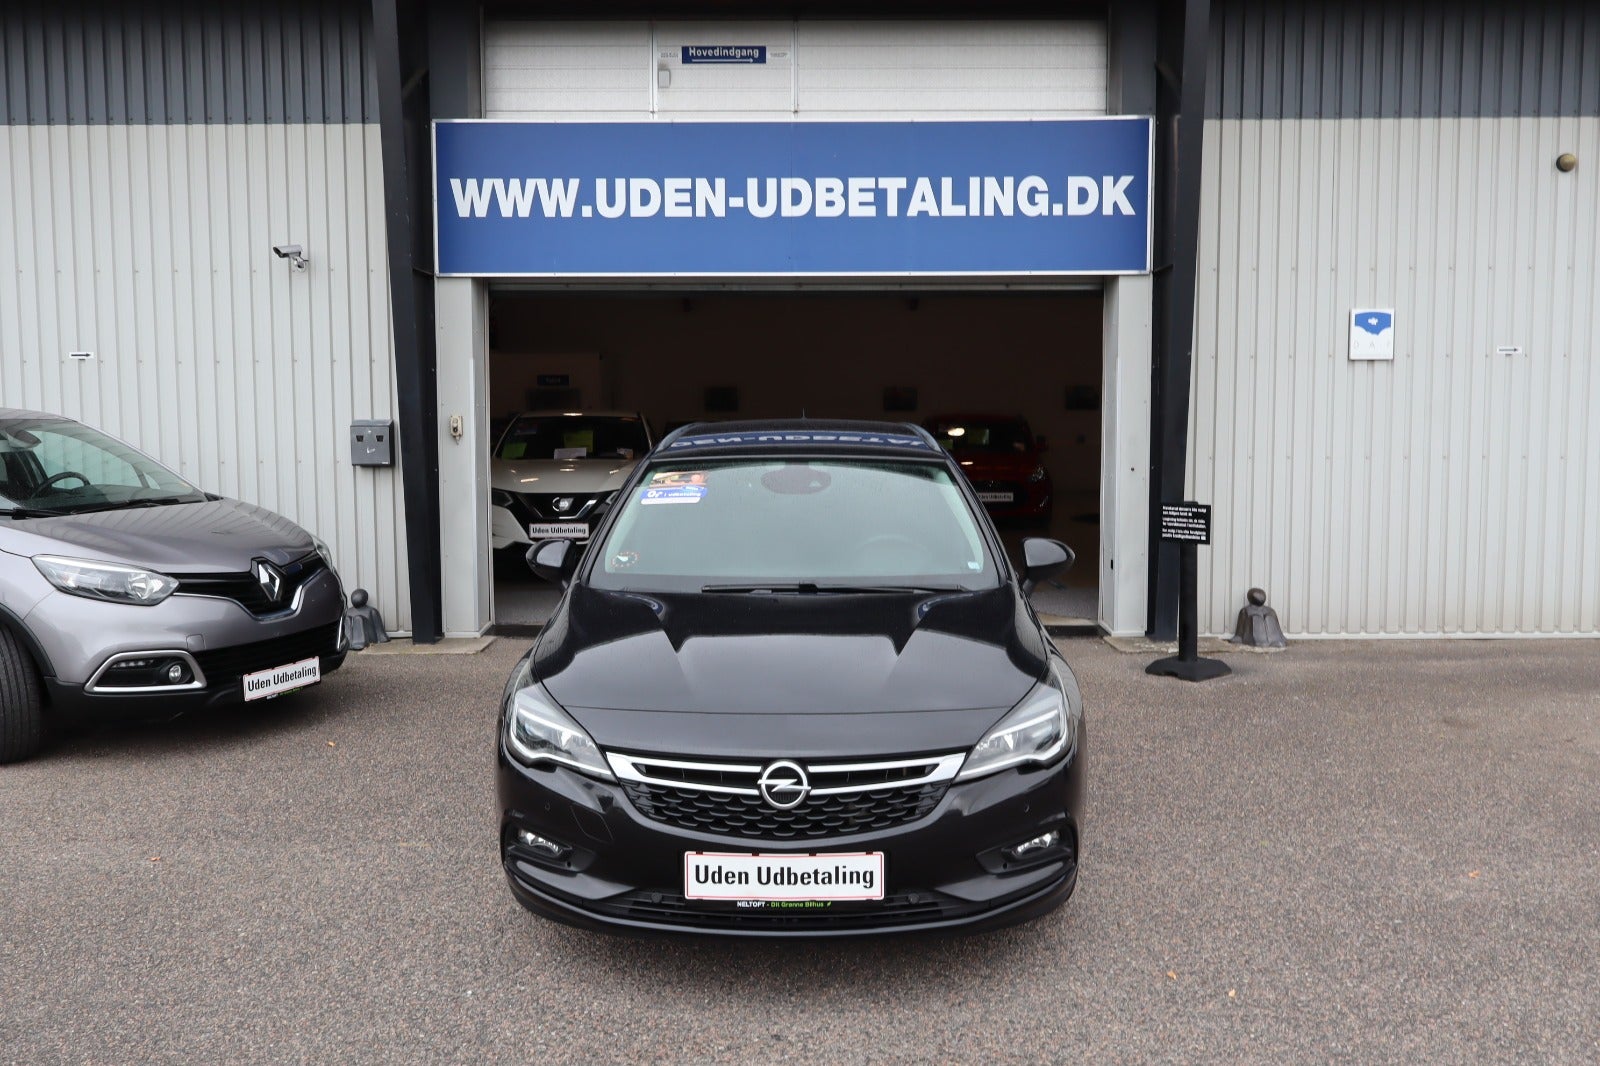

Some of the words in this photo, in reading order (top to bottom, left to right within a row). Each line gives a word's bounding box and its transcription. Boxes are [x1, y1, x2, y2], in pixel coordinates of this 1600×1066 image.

[689, 46, 759, 58] Hovedindgang
[449, 175, 1136, 218] WWW.UDEN-UDBETALING.DK
[532, 526, 549, 534] Uden
[550, 526, 586, 535] Udbetaling
[247, 679, 271, 692] Uden
[273, 666, 317, 685] Udbetaling
[694, 864, 750, 885] Uden
[757, 864, 874, 889] Udbetaling
[736, 900, 766, 908] NELTOFT
